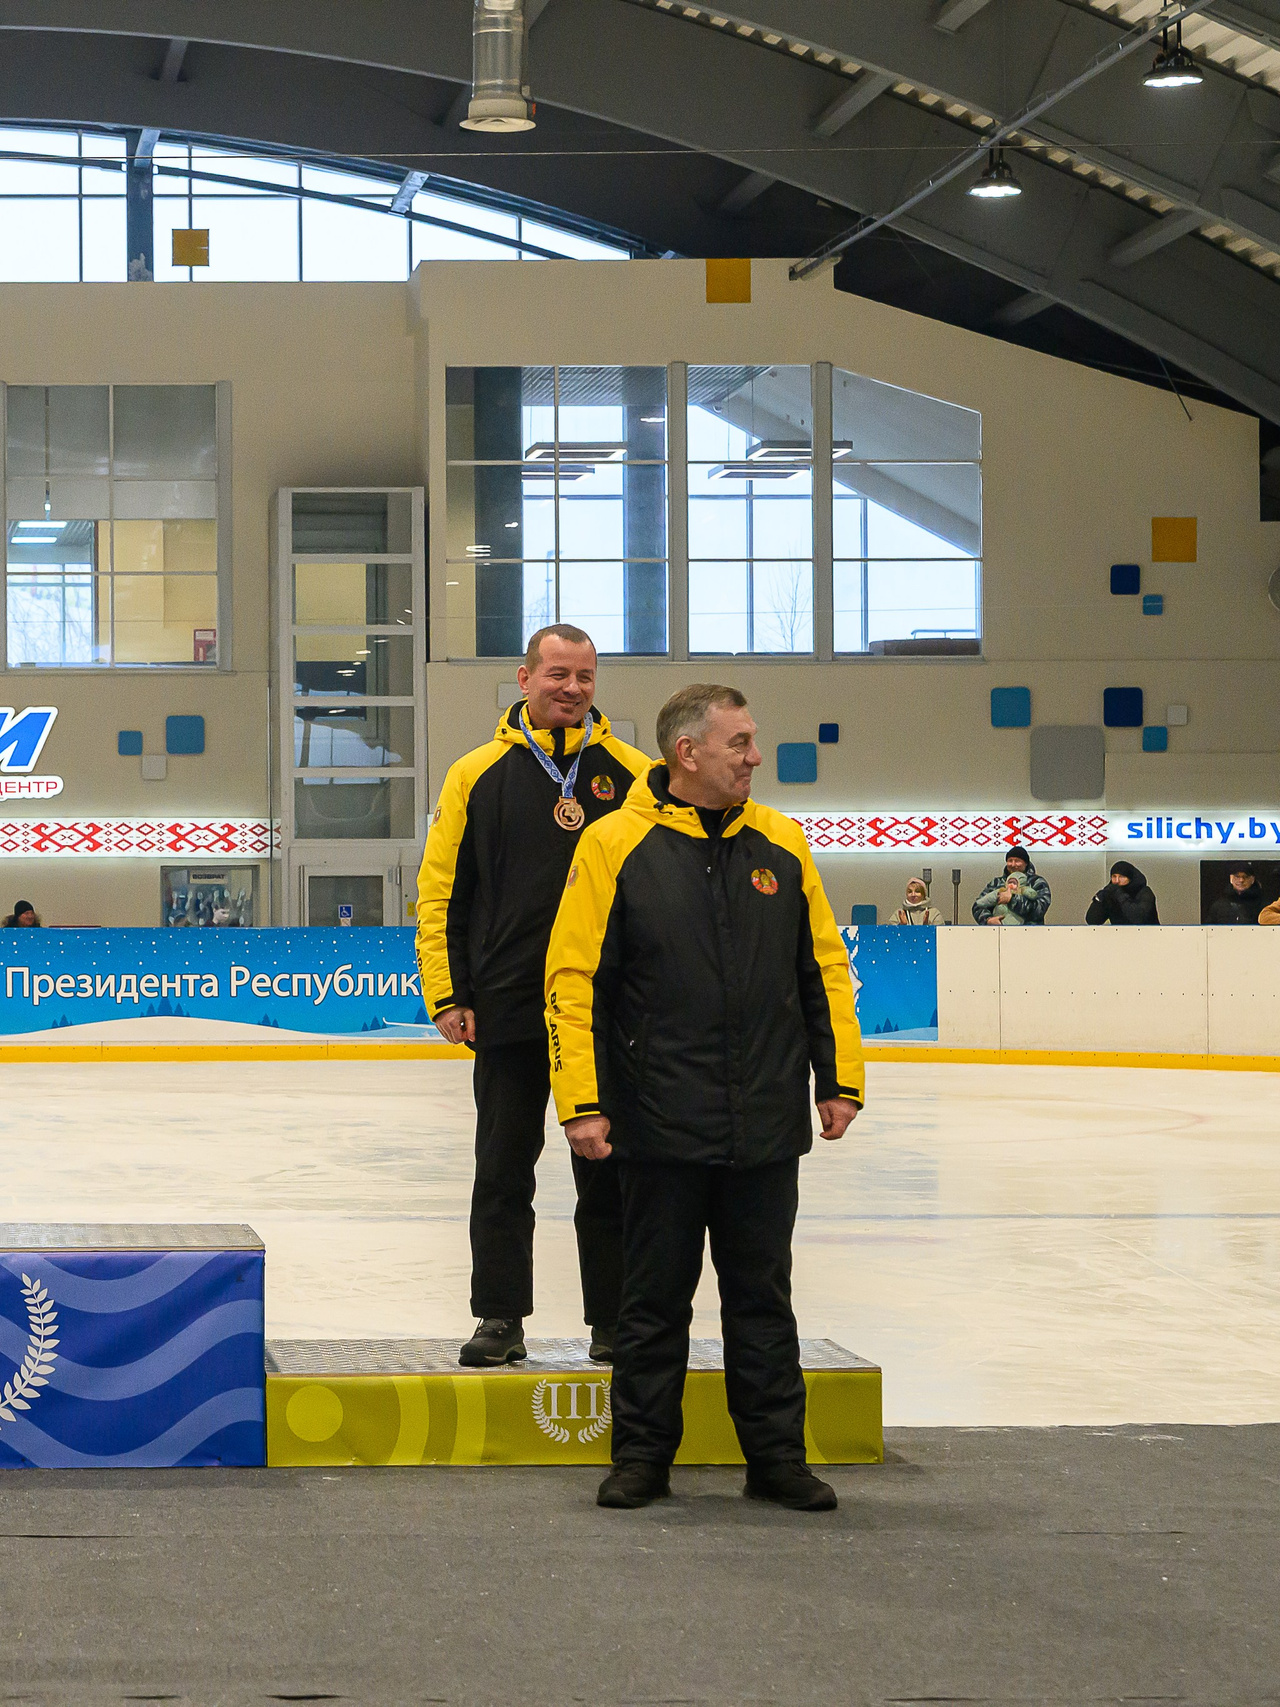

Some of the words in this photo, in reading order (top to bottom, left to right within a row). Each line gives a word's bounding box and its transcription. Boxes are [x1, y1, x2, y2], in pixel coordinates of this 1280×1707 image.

[5, 965, 220, 1006] Президента
[229, 963, 422, 1006] Республик
[546, 1382, 602, 1420] III
